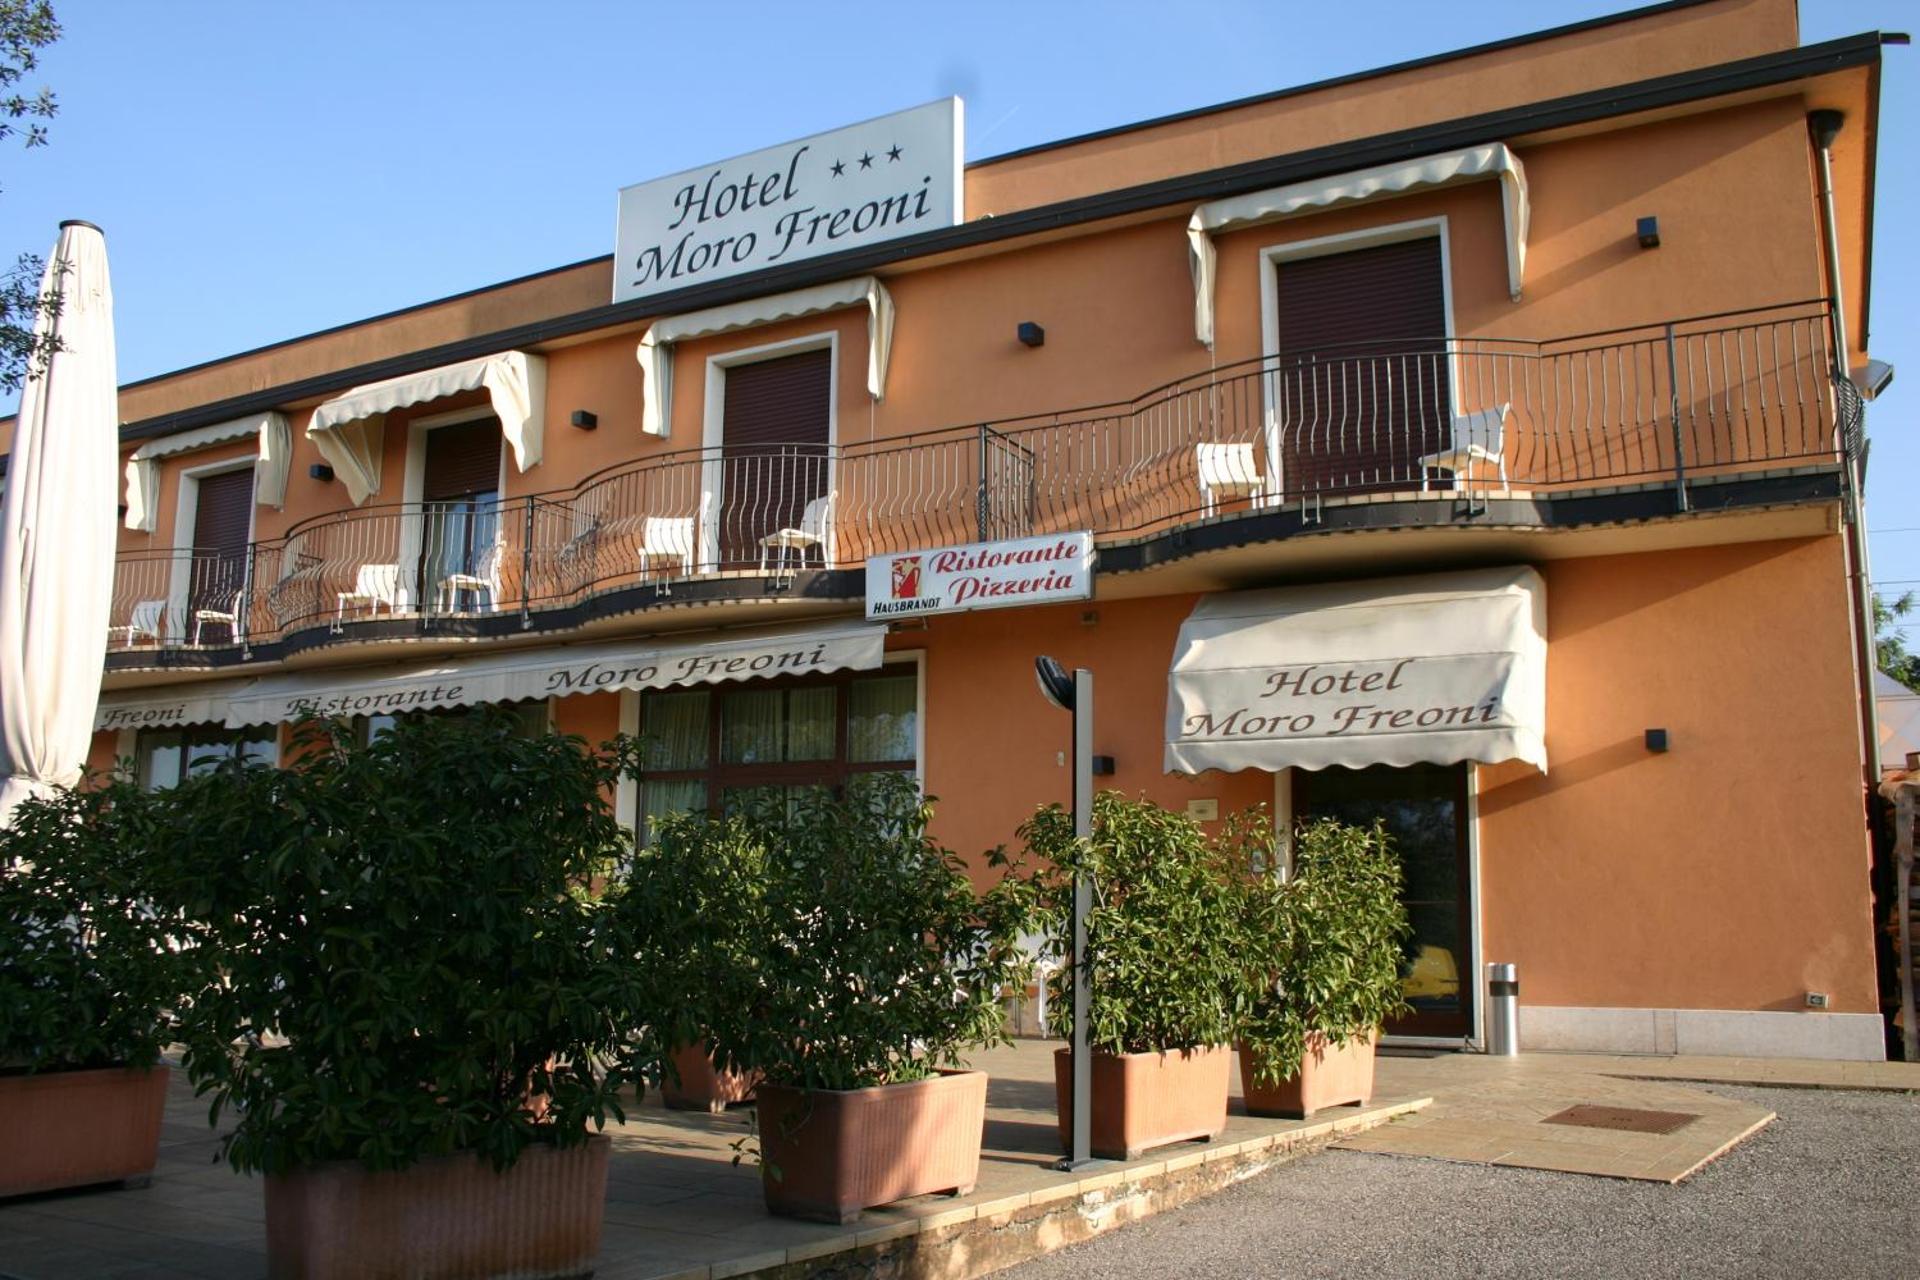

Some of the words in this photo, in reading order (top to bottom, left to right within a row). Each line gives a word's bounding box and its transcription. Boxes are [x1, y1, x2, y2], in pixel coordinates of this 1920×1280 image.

[668, 146, 809, 230] Hotel
[633, 231, 756, 287] Moro
[767, 176, 932, 262] Freoni
[929, 541, 1077, 574] Ristorante
[873, 598, 940, 614] HAUSBRANDT
[949, 570, 1074, 605] Pizzeria
[284, 685, 463, 717] Ristorante
[546, 664, 656, 691] Moro
[671, 644, 827, 682] Freoni
[1260, 658, 1416, 698] Hotel
[101, 704, 187, 728] Freoni
[1181, 708, 1314, 737] Moro
[1326, 697, 1499, 736] Freoni
